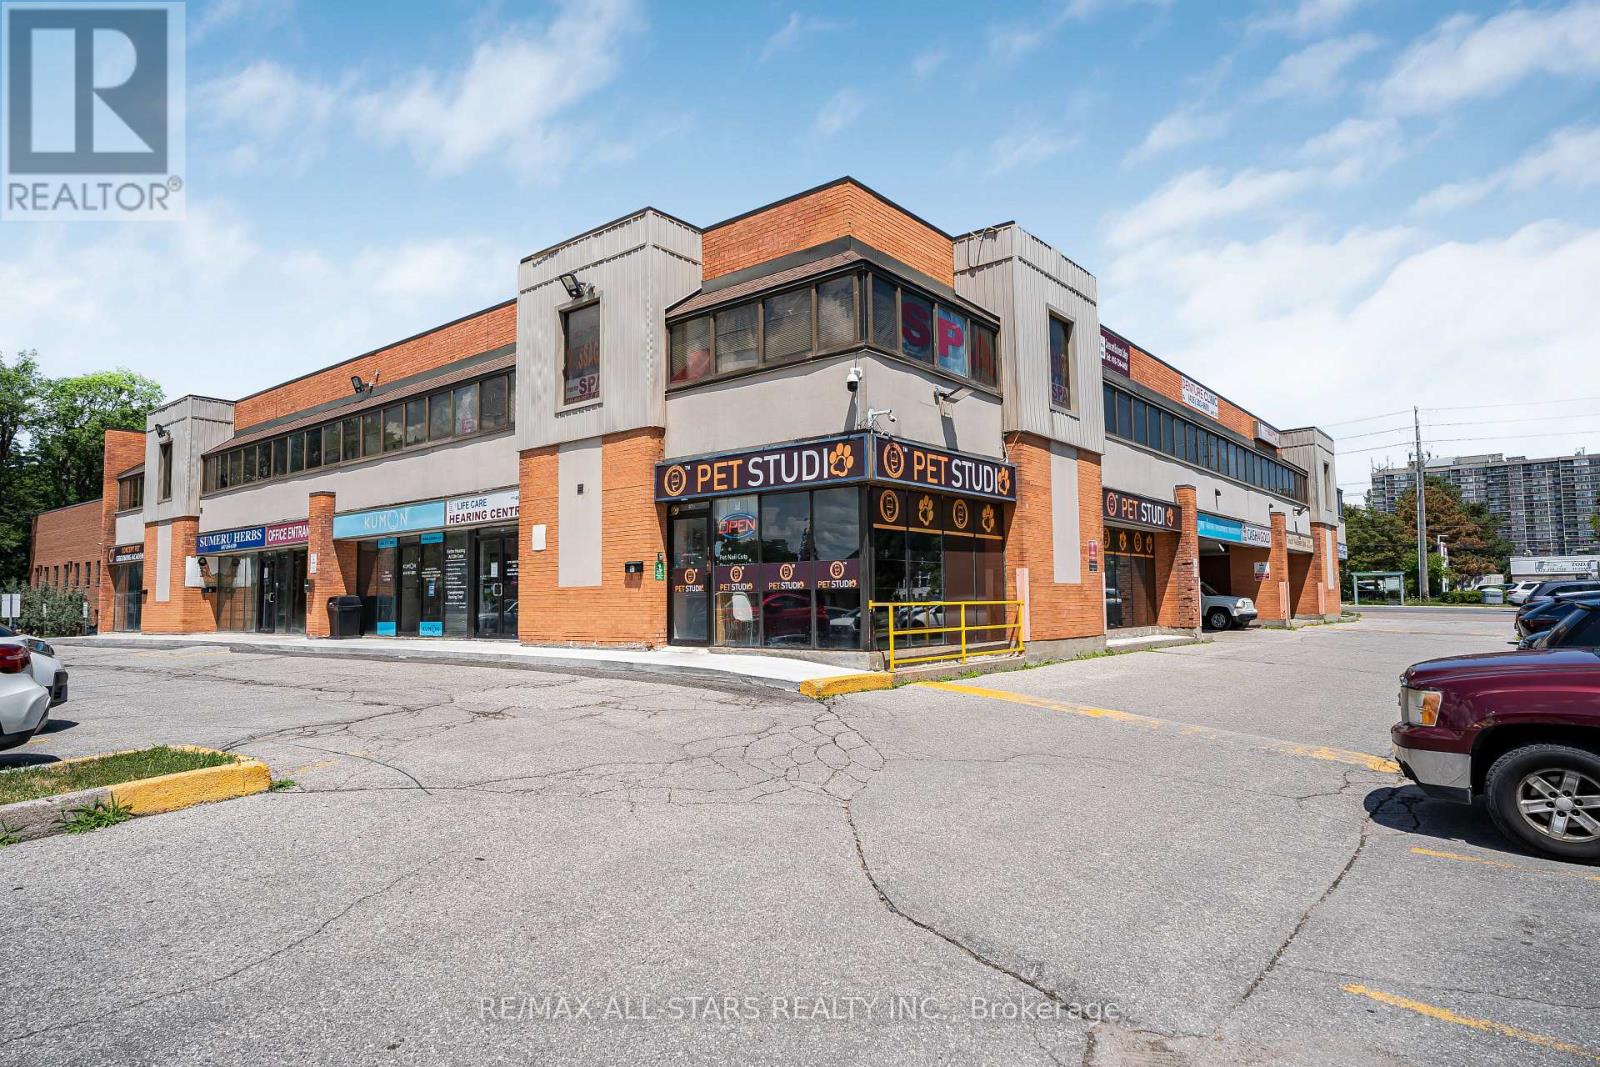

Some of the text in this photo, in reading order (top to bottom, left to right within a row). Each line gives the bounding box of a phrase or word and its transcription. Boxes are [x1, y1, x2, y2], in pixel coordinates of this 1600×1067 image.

[913, 450, 949, 485] PET
[696, 459, 743, 493] PET
[457, 500, 470, 511] LIFE
[470, 498, 488, 509] CARE
[1121, 497, 1139, 520] PET
[364, 510, 408, 530] KUMON
[449, 510, 488, 524] HEARING
[718, 518, 756, 534] OPEN
[199, 532, 232, 547] SUMERU
[233, 528, 262, 543] HERBS
[268, 528, 287, 542] OFFICE
[675, 584, 685, 592] PET
[720, 583, 731, 591] PET
[769, 582, 781, 590] PET
[817, 580, 831, 589] PET
